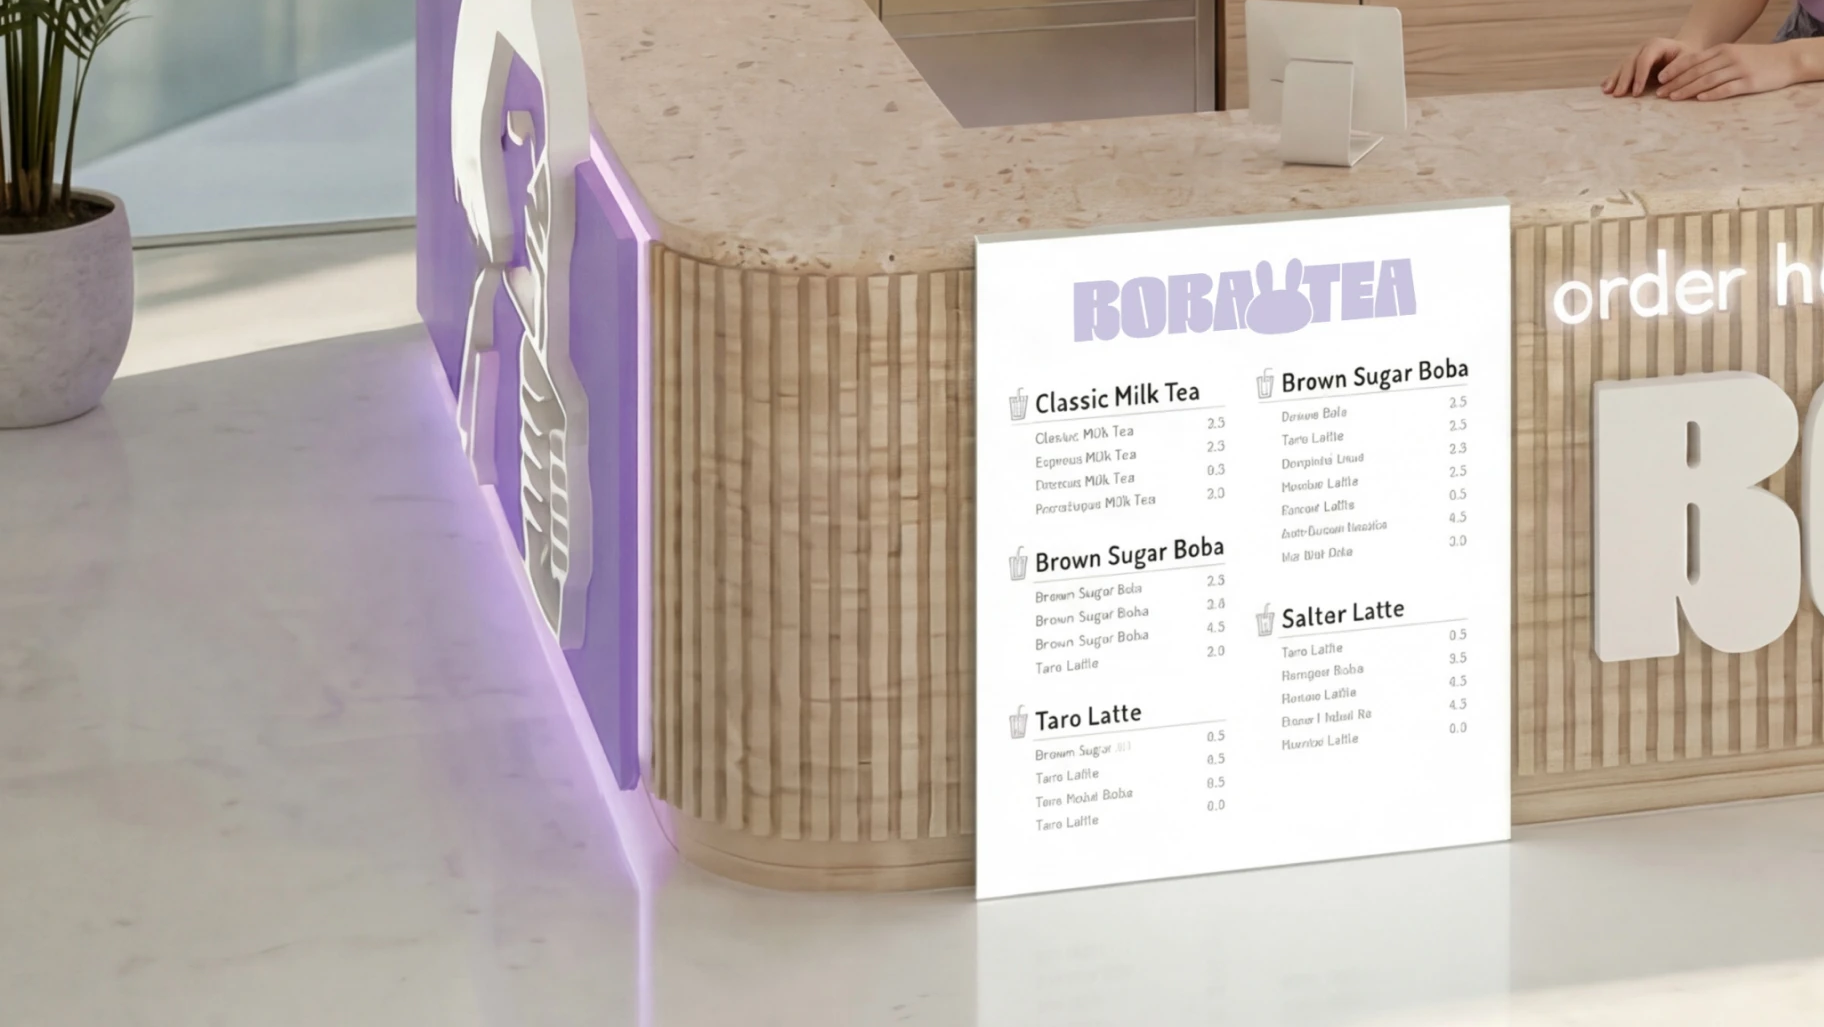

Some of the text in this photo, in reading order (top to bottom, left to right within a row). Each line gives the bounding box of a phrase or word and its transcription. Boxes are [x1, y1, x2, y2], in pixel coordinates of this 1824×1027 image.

[1073, 258, 1417, 343] BOBA TEA
[1552, 248, 1747, 325] order
[1281, 356, 1470, 394] Brown Sugar Boba
[1035, 381, 1201, 415] Classic Milk Tea
[1035, 534, 1225, 573] Brown Sugar Boba
[1281, 600, 1405, 630] Salter Latte
[1034, 703, 1143, 732] Taro Latte
